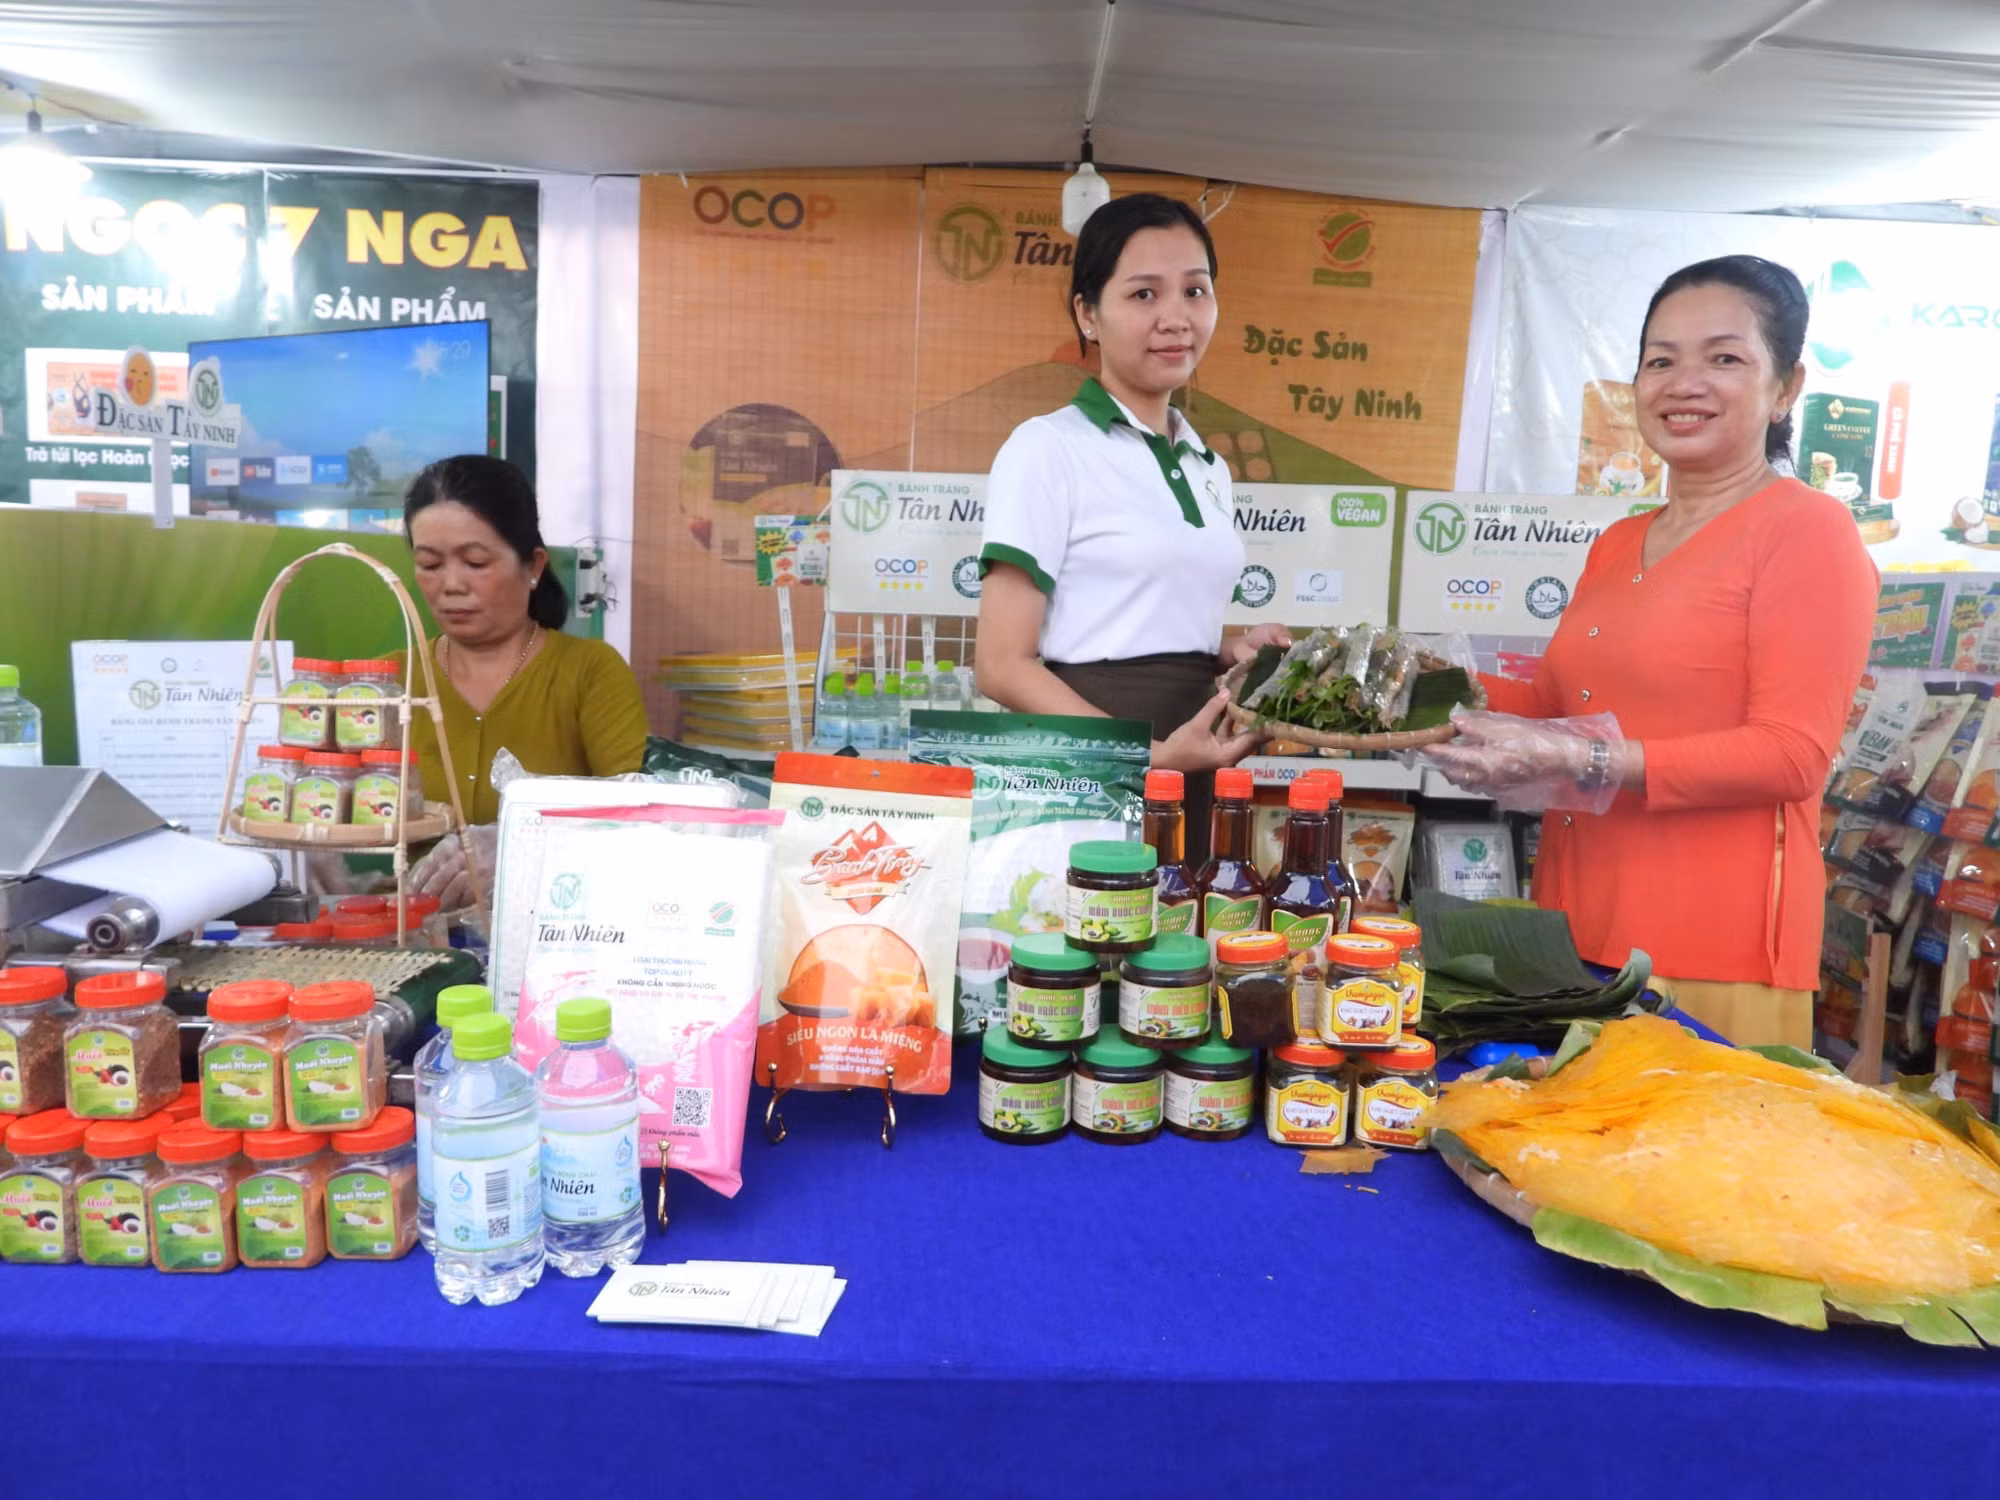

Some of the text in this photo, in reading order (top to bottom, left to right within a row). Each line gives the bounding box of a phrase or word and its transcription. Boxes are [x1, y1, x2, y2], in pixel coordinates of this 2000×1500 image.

[693, 185, 836, 231] OCOP
[346, 209, 528, 270] NGA
[1014, 230, 1073, 267] Tân
[42, 276, 107, 312] SẢN
[315, 286, 486, 323] SẢN PHẨM
[1244, 324, 1368, 366] Đặc Sản
[1288, 384, 1423, 422] Tây Ninh
[203, 426, 237, 444] NINH
[25, 446, 49, 463] Trà
[73, 447, 99, 467] lọc
[101, 449, 145, 466] Hoàn
[898, 483, 971, 495] BÁNH TRÁNG
[898, 496, 942, 522] Tân
[1337, 497, 1365, 508] 100%
[1474, 502, 1548, 515] BÁNH TRÁNG
[1233, 508, 1308, 533] Nhiên
[1336, 507, 1382, 523] VEGAN
[1473, 517, 1600, 544] Tân Nhiên
[874, 558, 928, 574] OCOP
[1447, 579, 1502, 595] OCOP
[164, 687, 245, 703] Tân Nhiên
[1006, 774, 1100, 794] Tân Nhiên
[830, 804, 934, 821] ĐẶC SẢN TÂY NINH
[537, 923, 625, 944] Tân Nhiên
[617, 978, 645, 987] KHÔNG
[787, 1025, 922, 1053] SIÊU NGON LẠ MIỆNG
[550, 1176, 596, 1196] Nhiên
[660, 1284, 686, 1296] Tân
[688, 1286, 731, 1297] Nhiên
